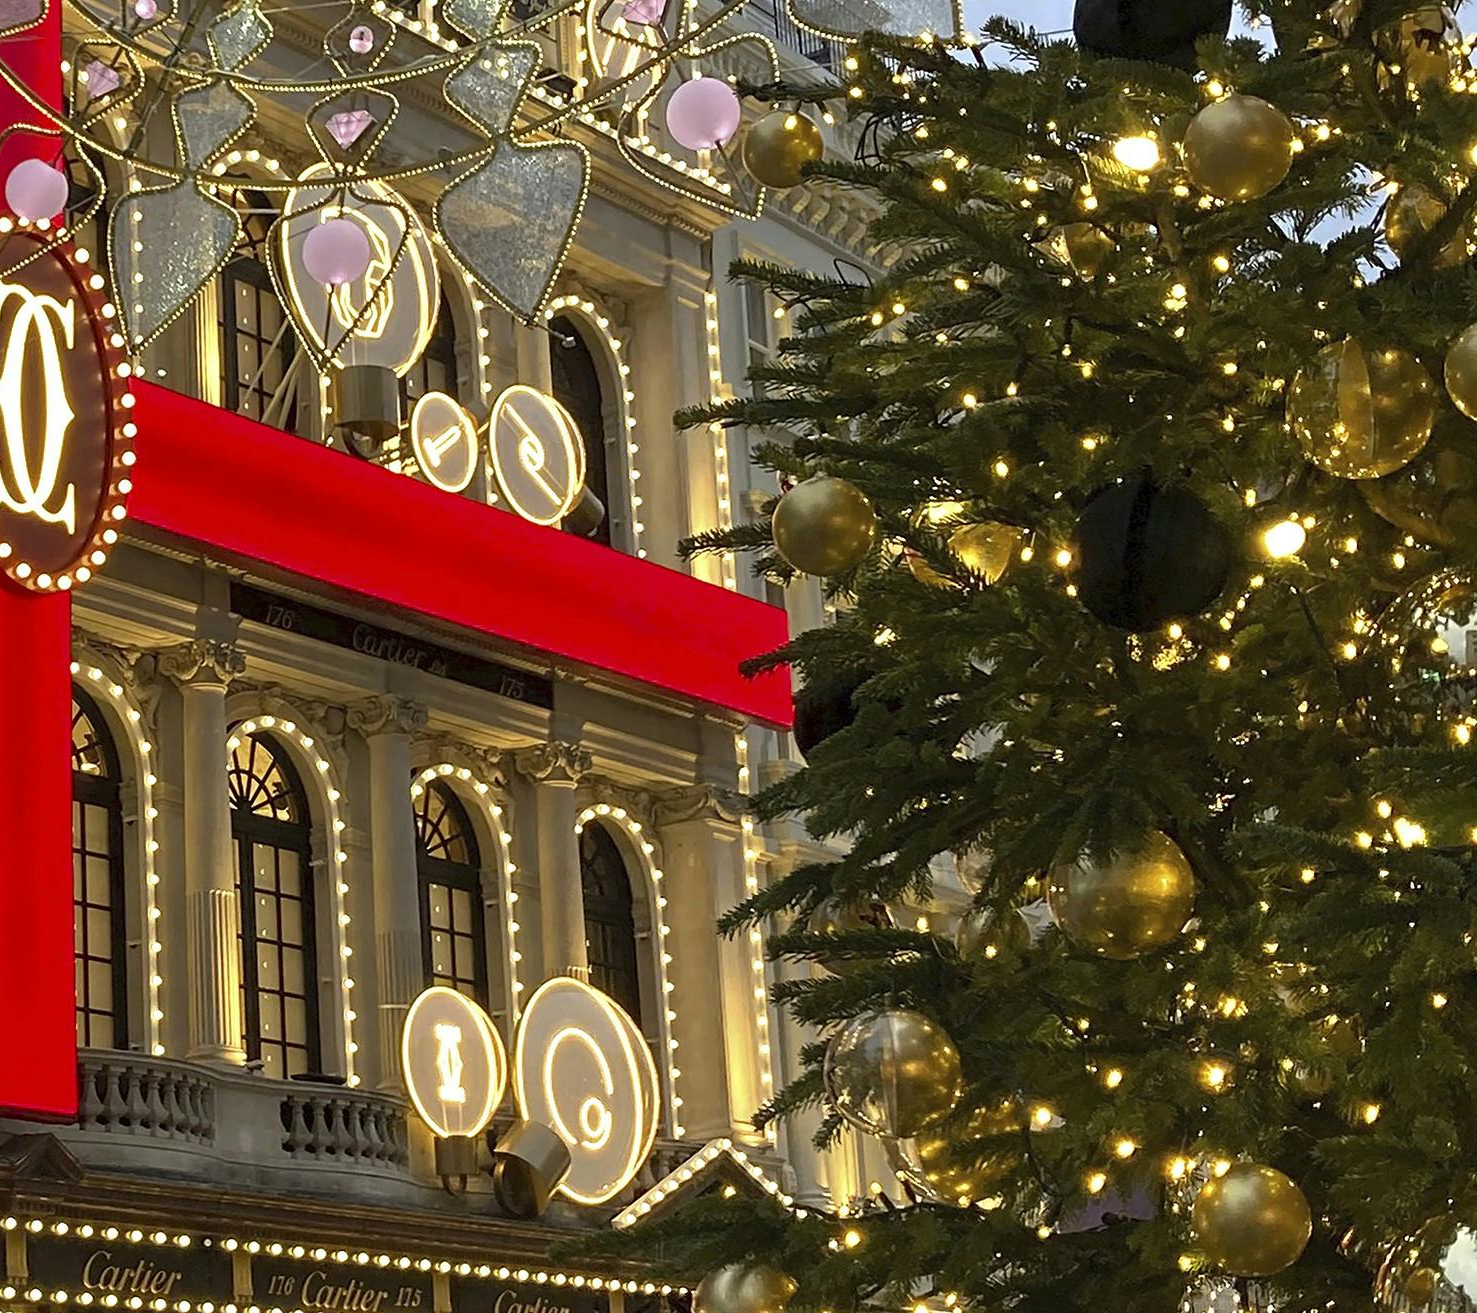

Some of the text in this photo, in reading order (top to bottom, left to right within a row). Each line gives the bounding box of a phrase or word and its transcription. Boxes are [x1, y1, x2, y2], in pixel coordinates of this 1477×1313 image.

[352, 623, 426, 670] Cartier
[499, 674, 525, 700] 175
[83, 1250, 182, 1294] Cartier
[268, 1271, 423, 1312] 176 Cartier 175
